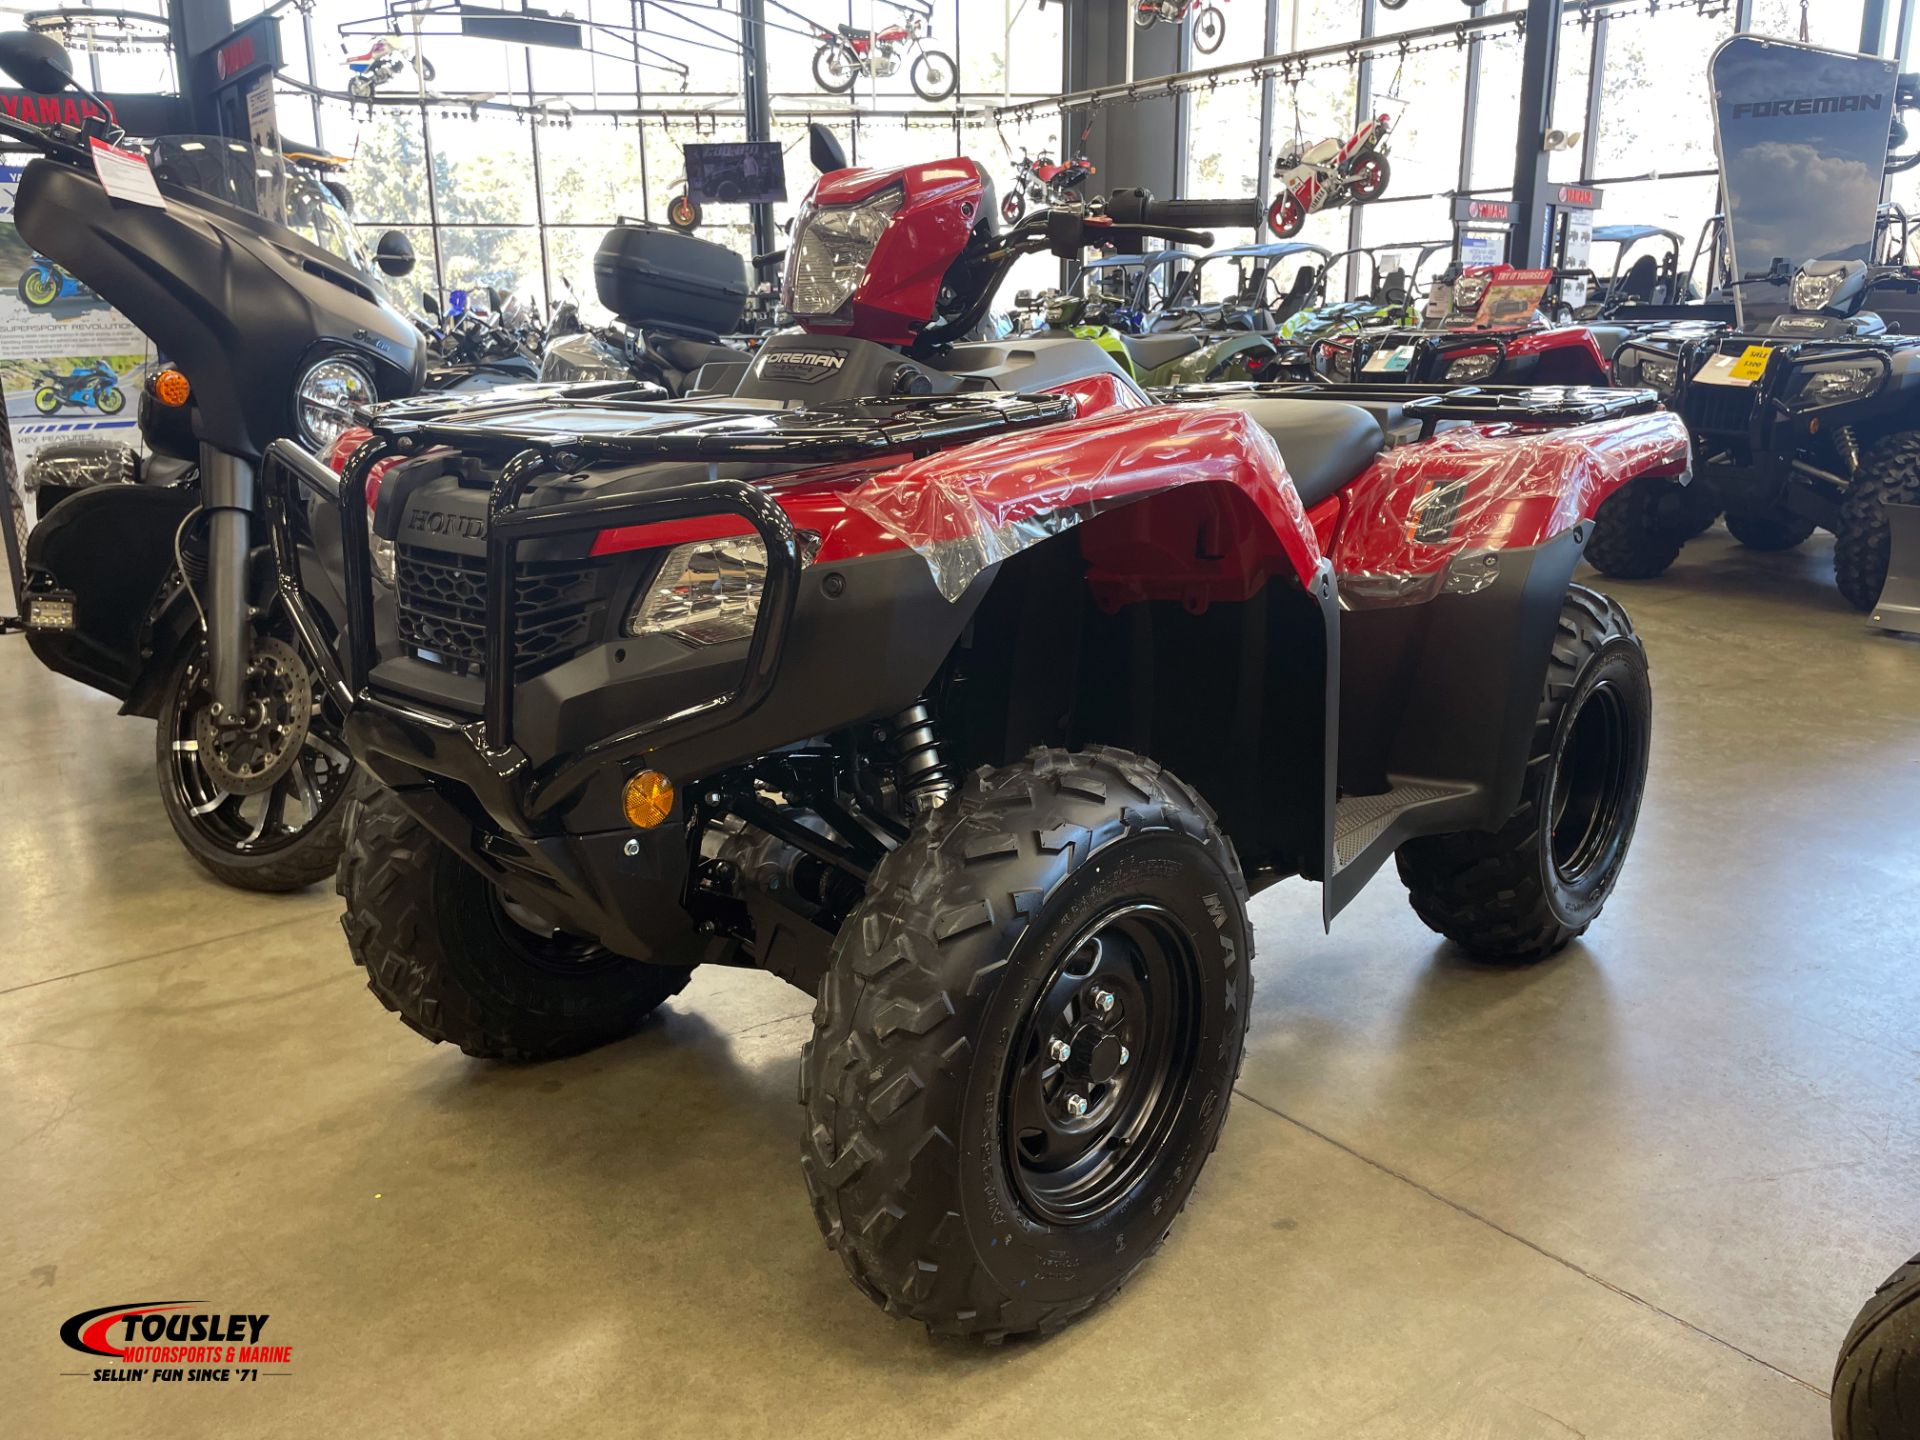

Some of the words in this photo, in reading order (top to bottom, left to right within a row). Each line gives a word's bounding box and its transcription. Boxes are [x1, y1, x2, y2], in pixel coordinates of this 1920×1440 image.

[1732, 94, 1882, 120] FOREMAN
[1567, 188, 1593, 205] YAMAHA
[1478, 202, 1508, 219] YAMAHA
[1517, 271, 1549, 280] YOURSELF
[0, 324, 68, 333] SUPERSPORT
[71, 322, 136, 331] REVOLUTION
[1779, 319, 1828, 329] RUBICON
[17, 436, 38, 444] KEY
[42, 434, 95, 442] FEATURES
